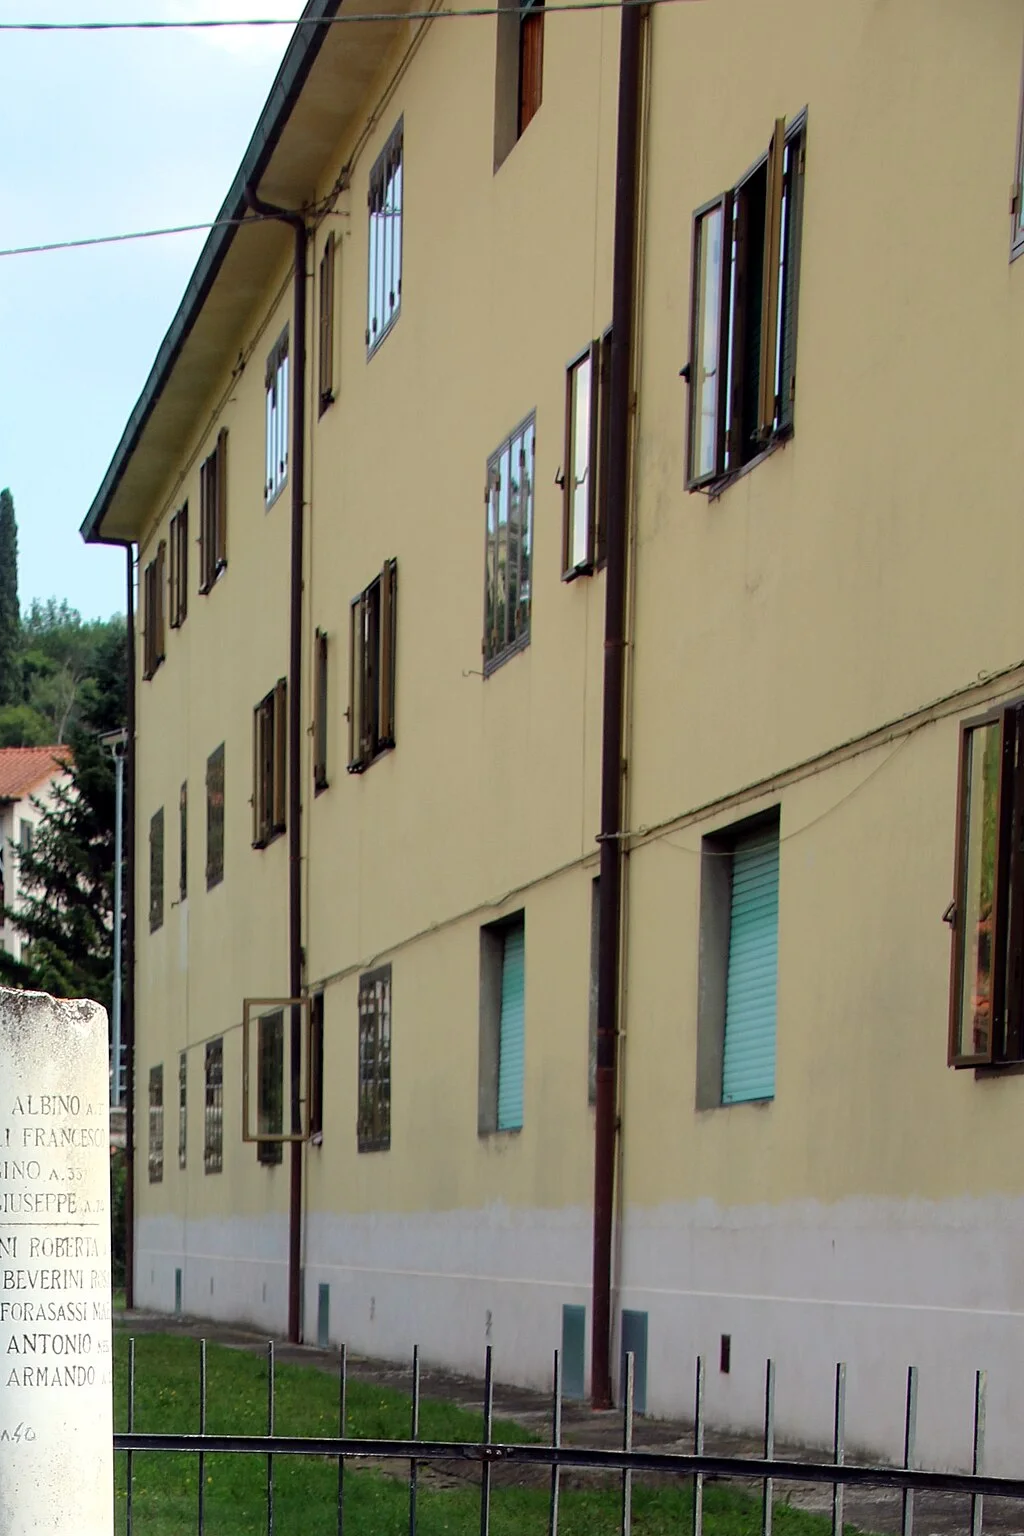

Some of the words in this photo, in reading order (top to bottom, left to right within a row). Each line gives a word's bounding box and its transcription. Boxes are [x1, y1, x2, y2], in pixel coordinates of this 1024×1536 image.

[12, 1095, 81, 1116] ALBINO
[23, 1127, 106, 1148] FRANCESCO
[29, 1236, 99, 1258] ROBERTA
[2, 1269, 84, 1290] BEVERINI
[0, 1301, 88, 1322] FORASASSI
[6, 1333, 92, 1355] ANTONIO
[5, 1365, 95, 1387] ARMANDO
